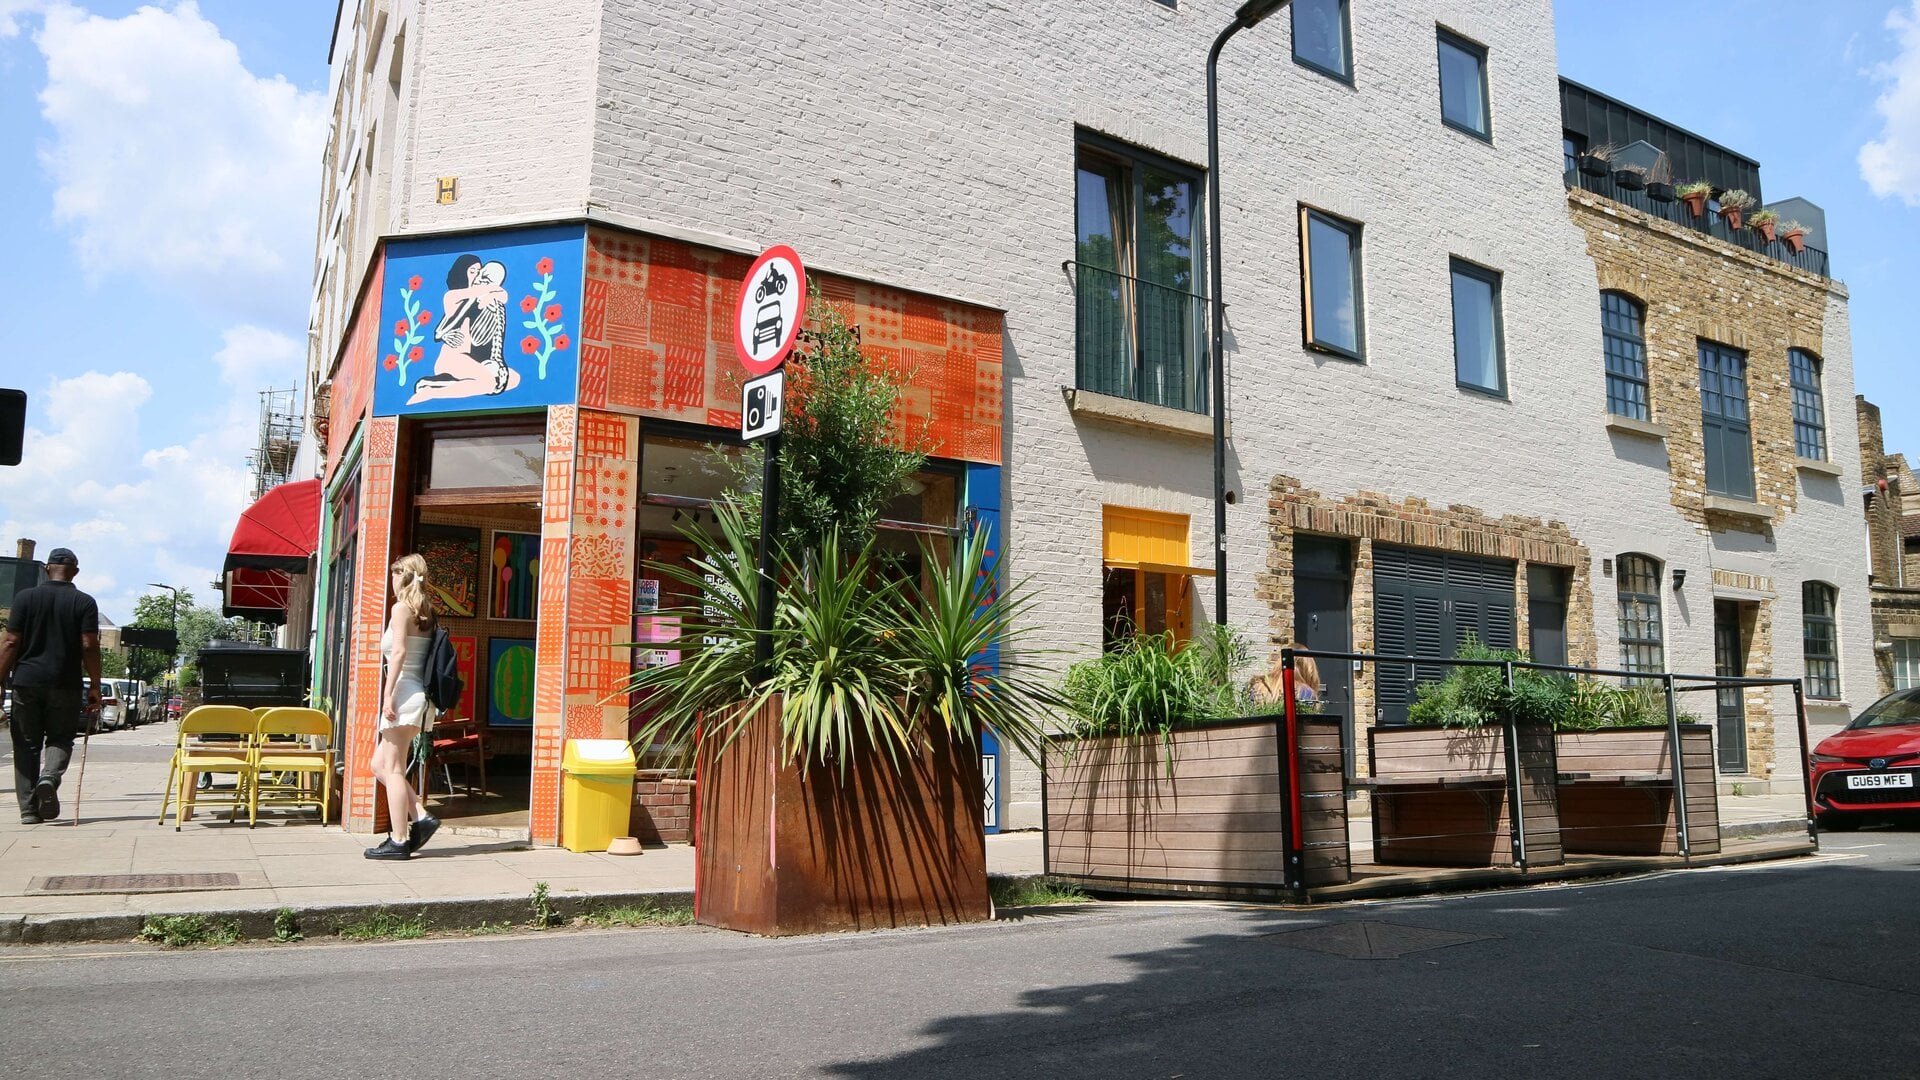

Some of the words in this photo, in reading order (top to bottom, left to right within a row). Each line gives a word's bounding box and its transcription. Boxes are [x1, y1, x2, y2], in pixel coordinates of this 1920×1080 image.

[439, 178, 456, 200] H
[1852, 776, 1881, 787] GU69
[1883, 775, 1906, 785] MFE
